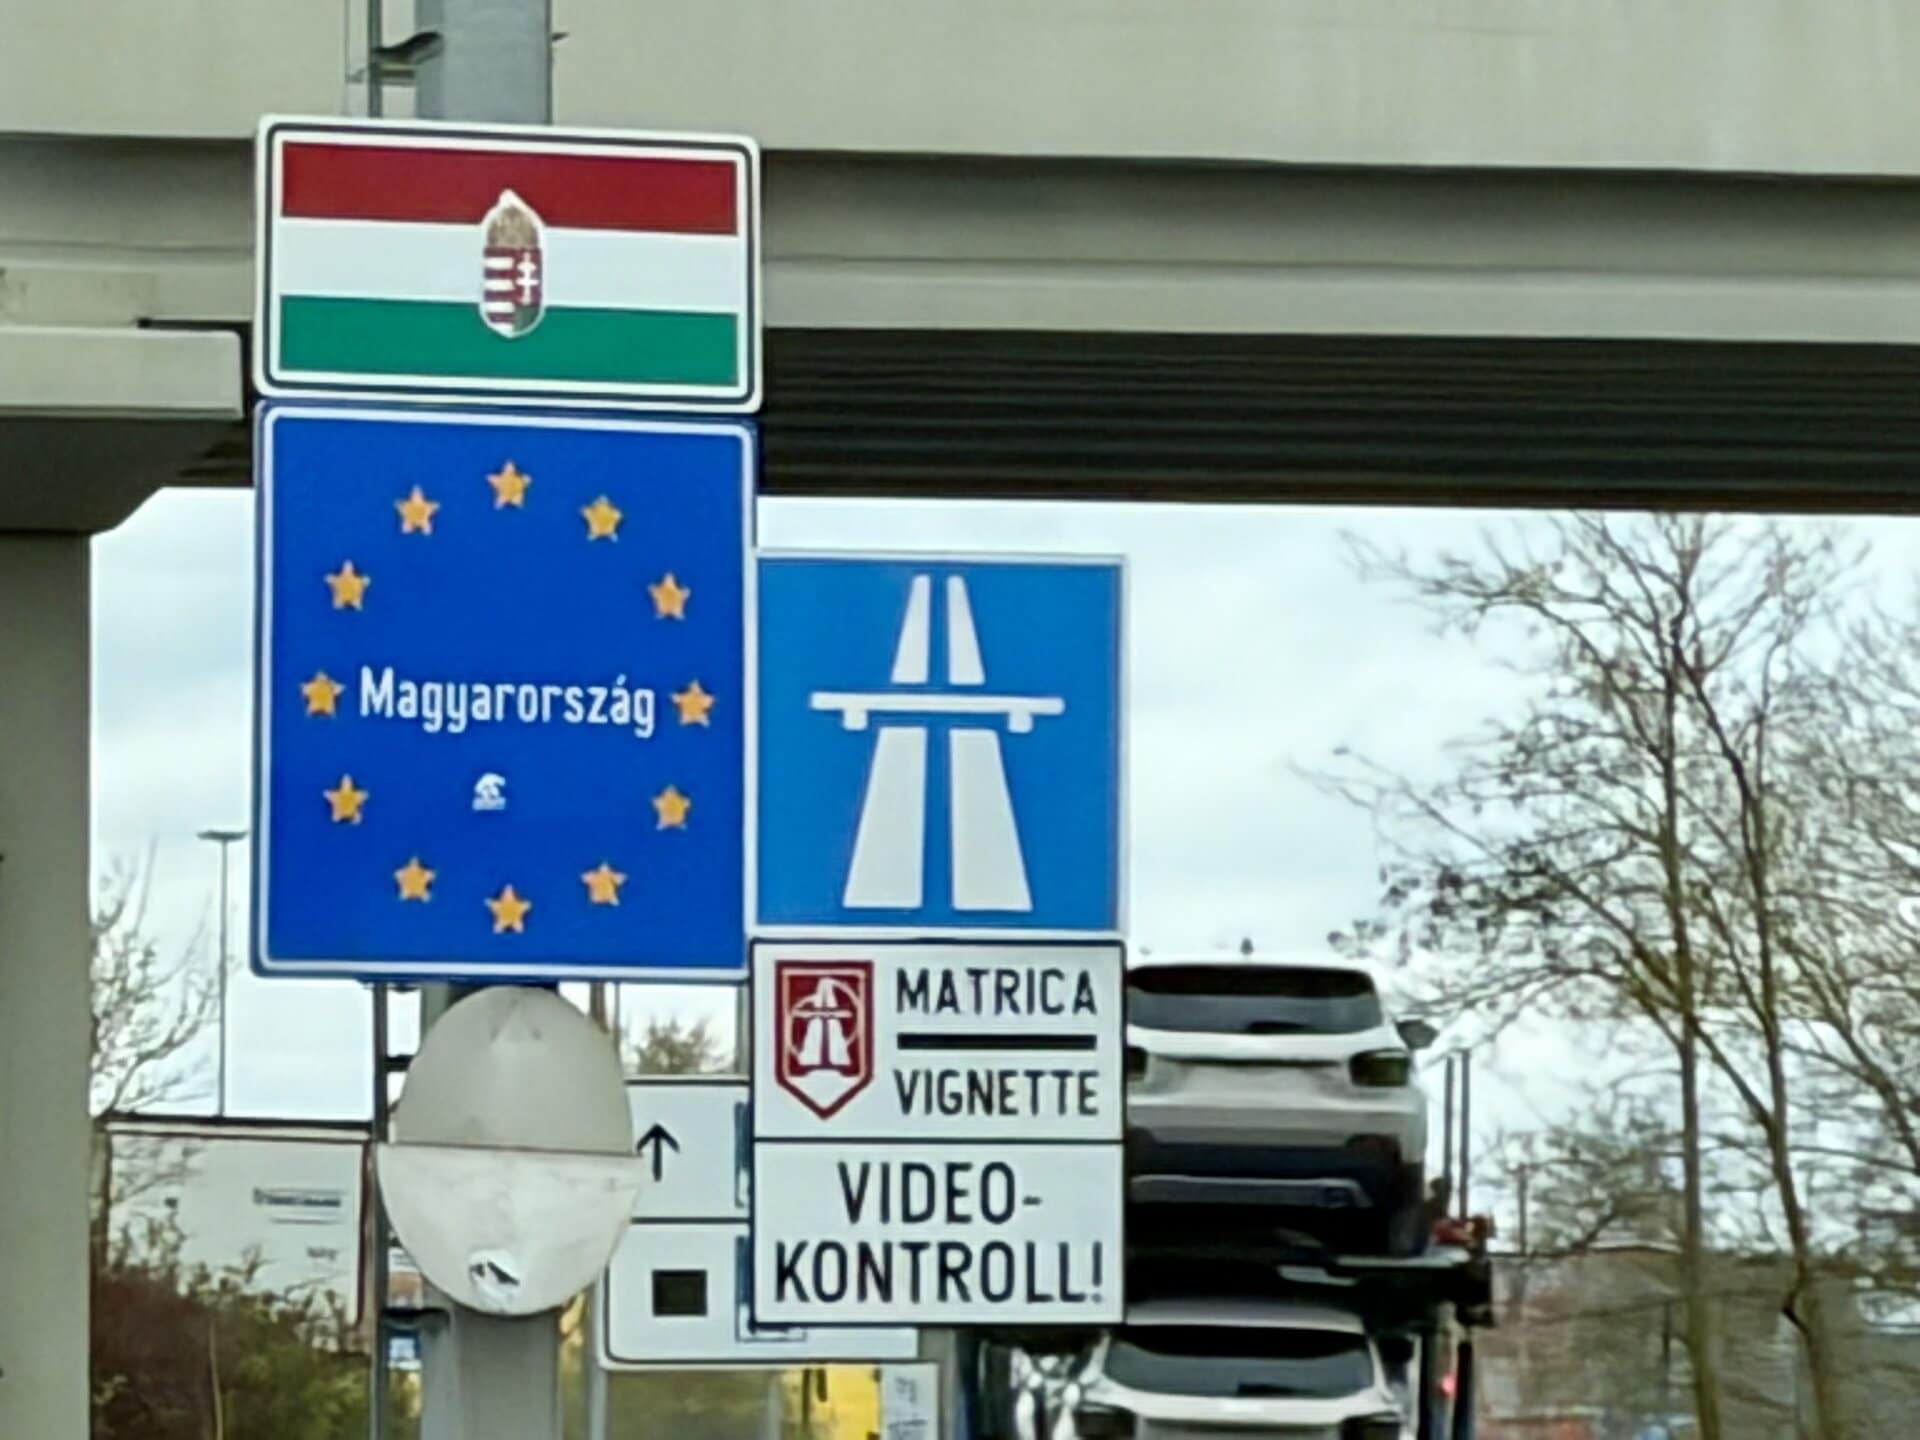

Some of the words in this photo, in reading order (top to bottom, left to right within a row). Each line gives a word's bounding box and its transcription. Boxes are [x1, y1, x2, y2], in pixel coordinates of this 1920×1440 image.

[359, 665, 655, 738] Magyarország
[896, 966, 1098, 1016] MATRICA
[893, 1069, 1099, 1117] VIGNETTE
[837, 1161, 1043, 1226] VIDEO-
[775, 1240, 1104, 1305] KONTROLL!
